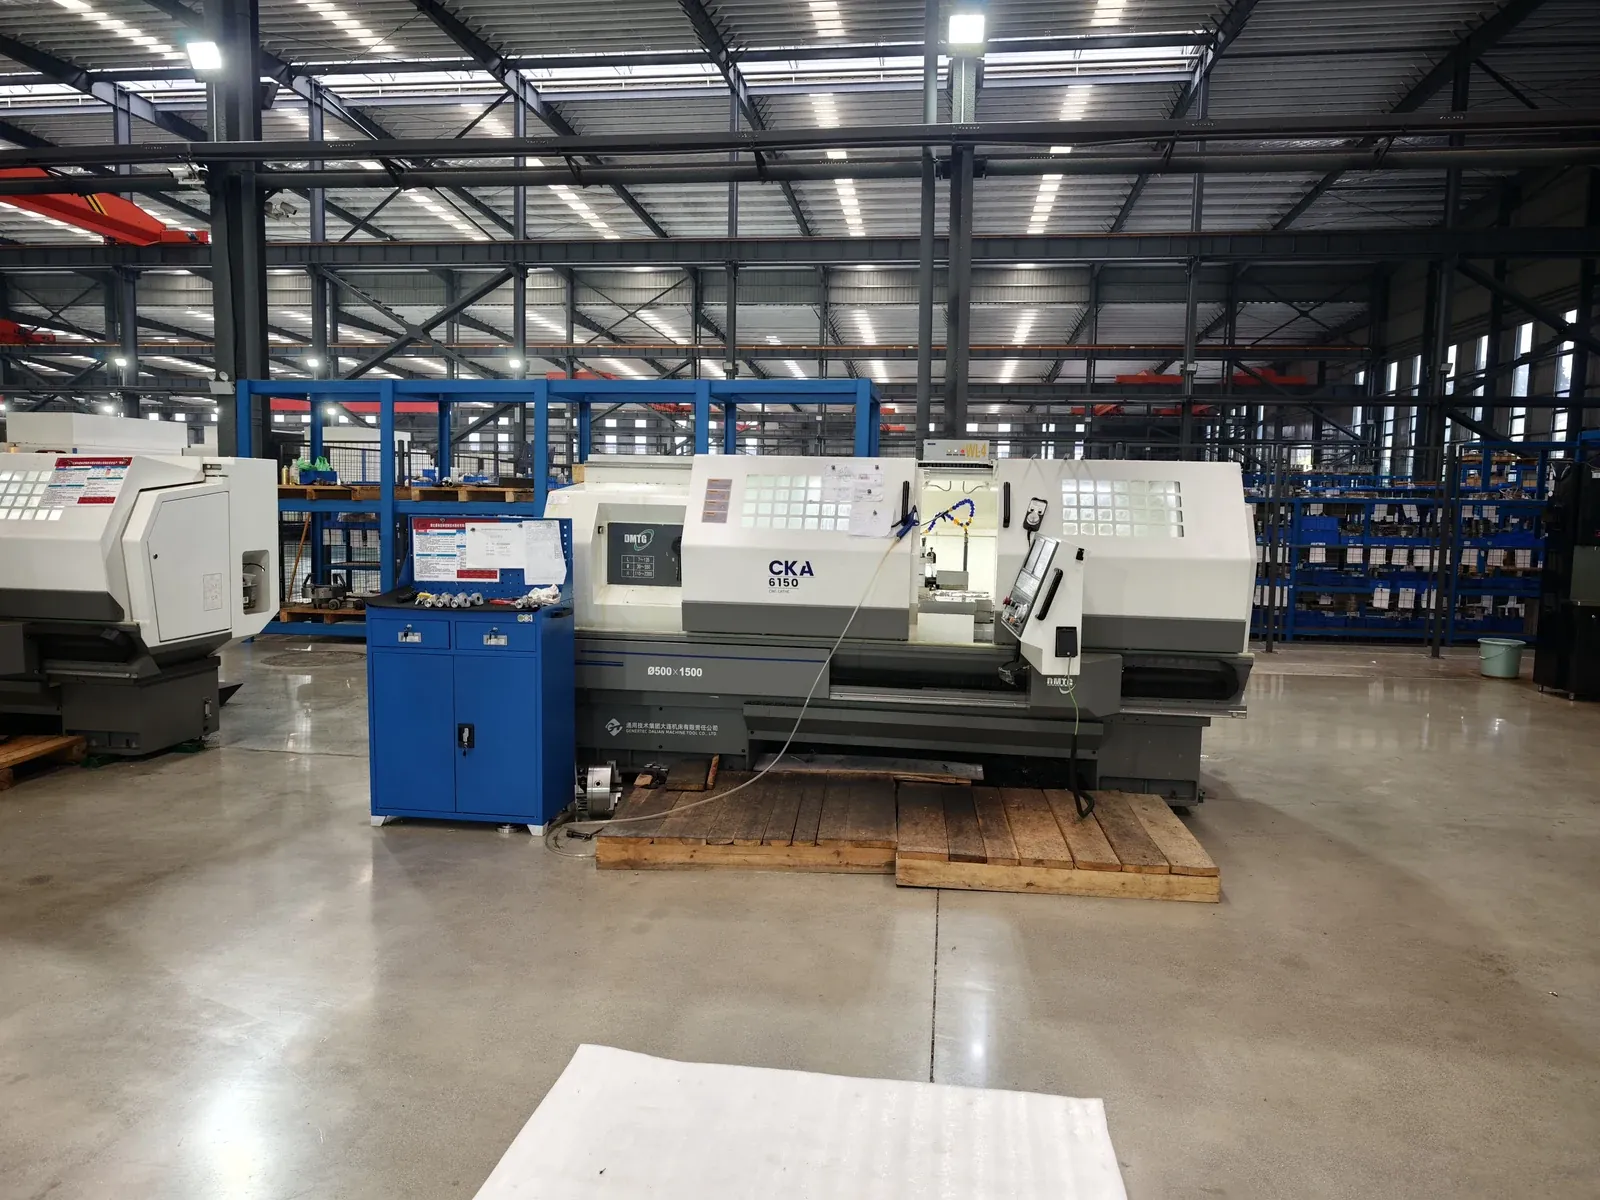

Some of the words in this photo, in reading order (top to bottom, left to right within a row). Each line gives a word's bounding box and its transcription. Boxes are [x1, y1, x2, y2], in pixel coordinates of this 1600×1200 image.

[624, 534, 647, 543] DMTG
[769, 560, 814, 576] CKA
[768, 578, 798, 587] 6150
